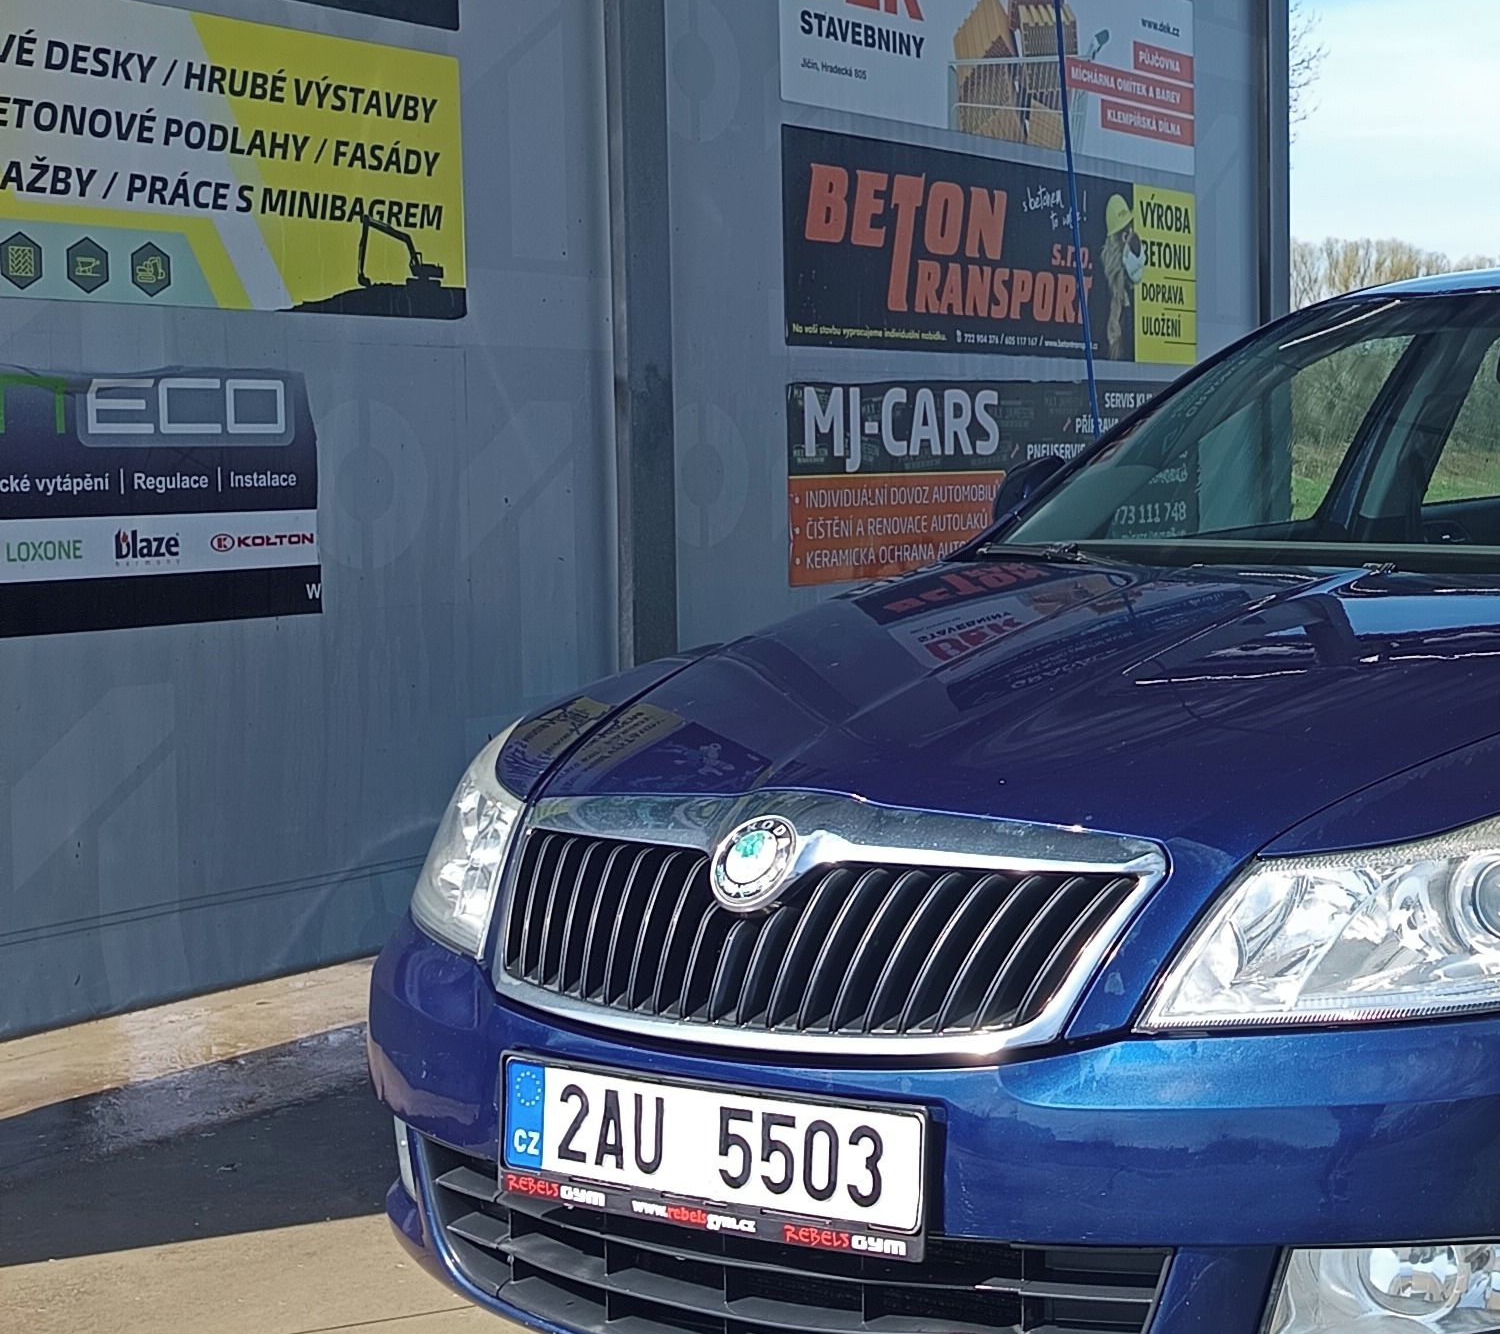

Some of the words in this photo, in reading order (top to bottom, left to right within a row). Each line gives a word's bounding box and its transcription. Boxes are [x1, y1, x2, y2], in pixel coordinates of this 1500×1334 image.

[799, 9, 925, 59] STAVEBNINY
[1140, 16, 1181, 38] www.dek.cz
[1138, 48, 1181, 73] PŮJČOVNA
[44, 38, 158, 85] DESKY
[184, 60, 288, 104] HRUBÉ
[293, 75, 439, 124] VÝSTAVBY
[1070, 63, 1116, 89] MÍCHÁRNA
[1116, 76, 1147, 97] OMÍTEK
[1155, 88, 1181, 105] BAREV
[1106, 107, 1157, 131] KLEMPÍŘSKÁ
[1157, 117, 1181, 136] DÍLNA
[163, 117, 311, 163] PODLAHY
[332, 139, 442, 178] FASÁDY
[125, 170, 232, 213] PRÁCE
[235, 184, 255, 214] S
[259, 185, 444, 232] MINIBAGREM
[804, 161, 1008, 267] BETON
[1139, 192, 1192, 235] VÝROBA
[1140, 240, 1192, 272] BETONU
[1141, 282, 1185, 306] DOPRAVA
[1142, 312, 1182, 339] ULOŽENÍ
[1104, 392, 1135, 409] SERVIS
[803, 386, 1000, 472] MJ-CARS
[35, 470, 111, 497] vytápění
[133, 471, 210, 496] Regulace
[230, 470, 298, 488] Instalace
[805, 483, 888, 510] INDIVIDUÁLNÍ
[891, 485, 929, 506] DOVOZ
[806, 514, 853, 540] ČIŠTĚNÍ
[855, 518, 865, 537] A
[867, 514, 928, 536] RENOVACE
[930, 507, 989, 532] AUTOLAKŮ
[1138, 502, 1161, 523] 111
[1164, 500, 1187, 522] 748
[5, 538, 84, 564] LOXONE
[805, 544, 877, 570] KERAMICKÁ
[878, 542, 936, 564] OCHRANA
[513, 1128, 540, 1156] CZ
[557, 1083, 665, 1175] 2AU
[718, 1105, 884, 1208] 5503
[506, 1173, 560, 1198] REBELS
[630, 1199, 757, 1234] www.rebelsgym.cz
[783, 1223, 850, 1249] REBELS
